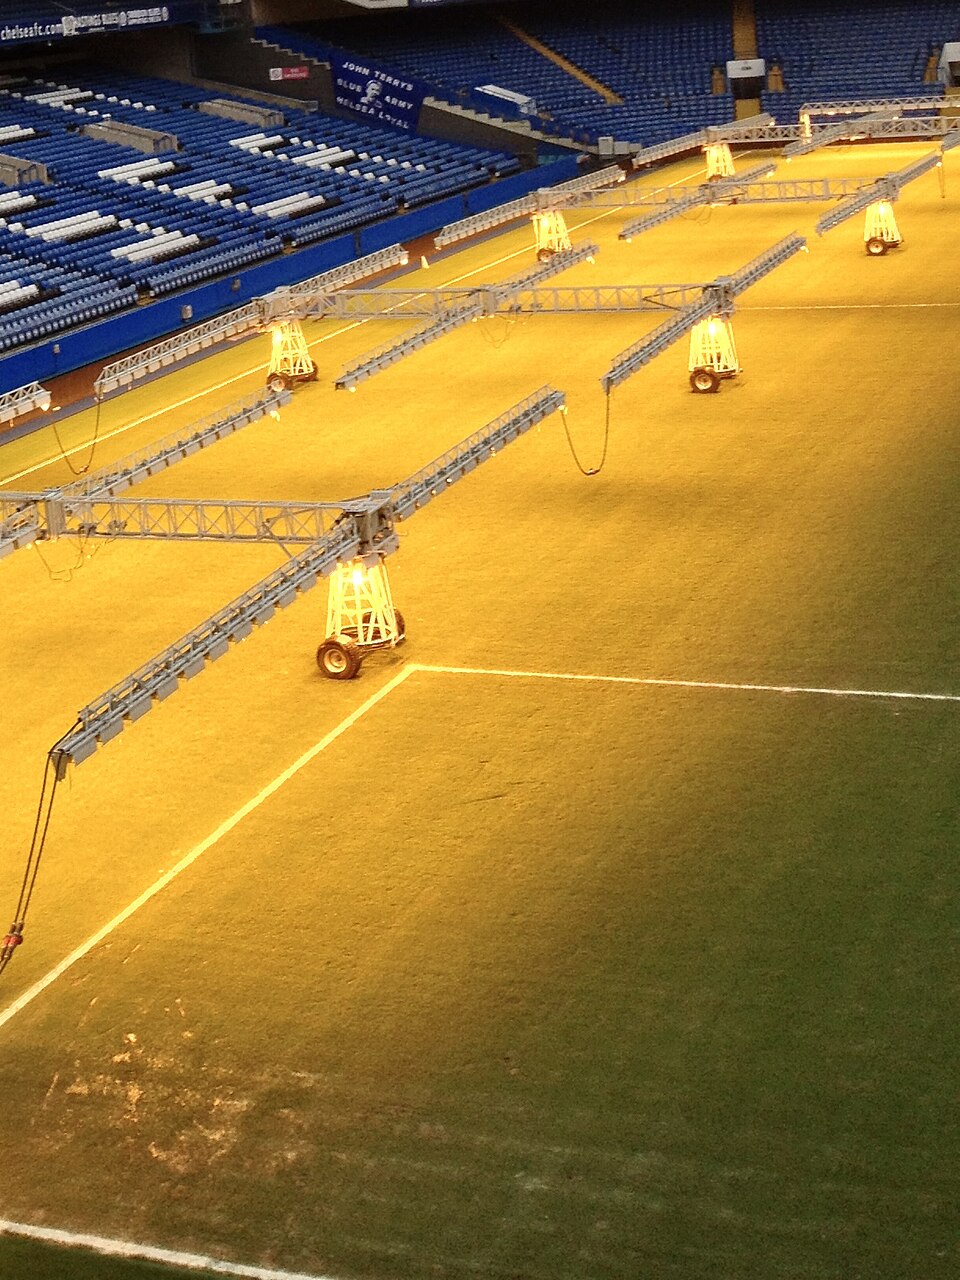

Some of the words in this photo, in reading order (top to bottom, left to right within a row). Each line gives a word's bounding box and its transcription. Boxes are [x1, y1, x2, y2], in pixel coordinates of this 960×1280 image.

[0, 22, 62, 41] chelseafc.com
[342, 61, 370, 76] JOHN
[374, 70, 414, 92] TERRYS
[336, 78, 362, 93] BLUE
[384, 95, 414, 110] ARMY
[336, 96, 375, 115] HELSEA
